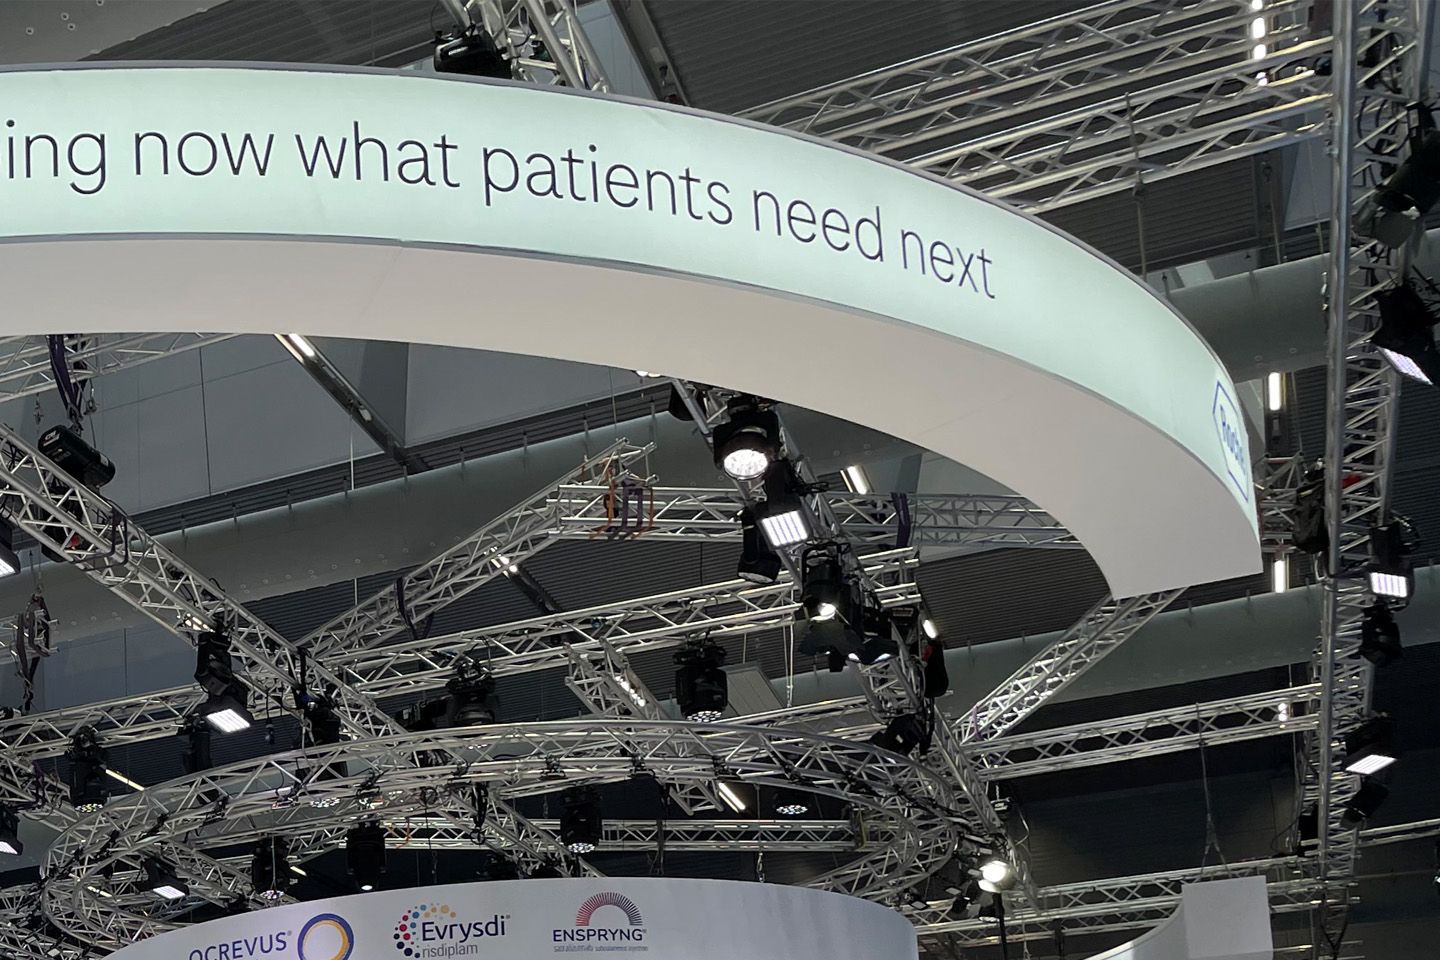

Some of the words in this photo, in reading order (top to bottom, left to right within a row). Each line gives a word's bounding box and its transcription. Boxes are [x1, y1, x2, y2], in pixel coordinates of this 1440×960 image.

[134, 130, 275, 177] now
[295, 121, 461, 188] what
[483, 144, 733, 226] patients
[752, 187, 884, 262] need
[901, 228, 996, 299] next
[421, 915, 505, 942] Evrysdi
[422, 943, 479, 959] risdiplam
